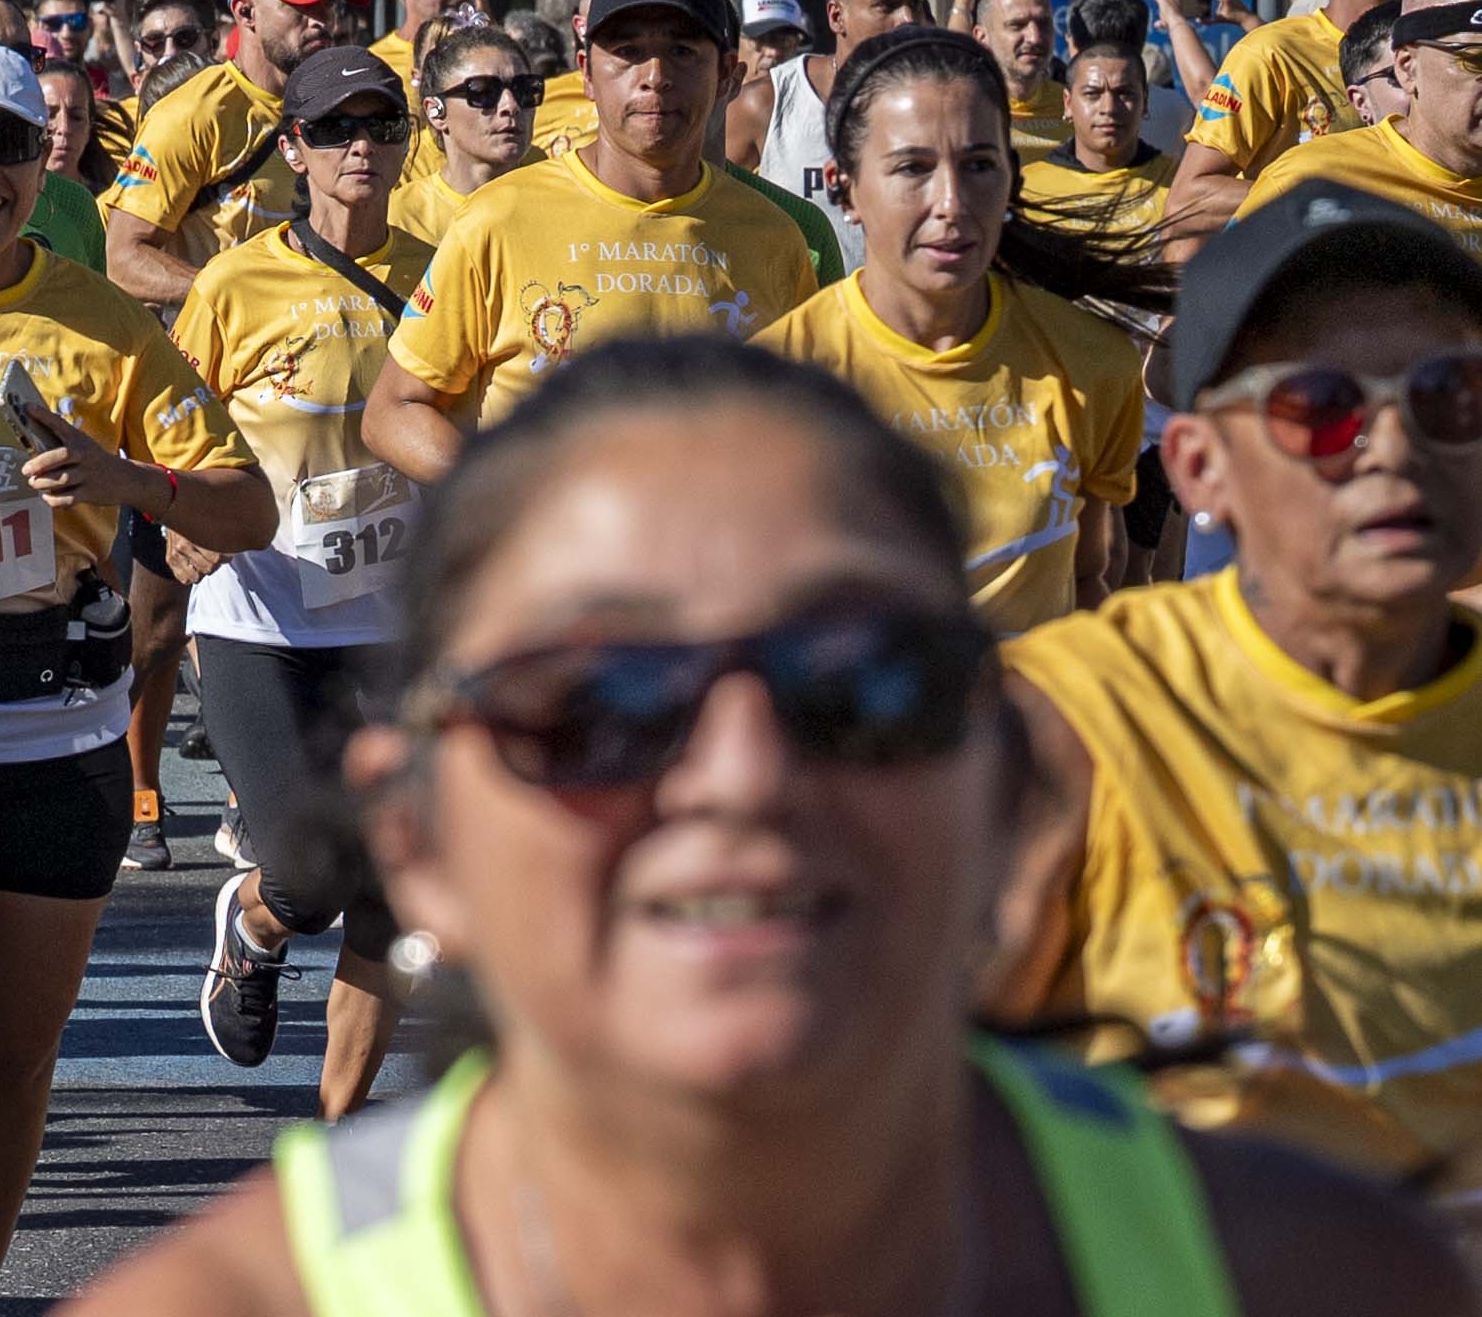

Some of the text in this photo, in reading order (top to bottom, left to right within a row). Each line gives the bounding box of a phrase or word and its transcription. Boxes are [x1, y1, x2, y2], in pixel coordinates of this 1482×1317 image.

[1206, 89, 1243, 114] LADINI
[567, 239, 730, 271] 1° MARATÓN
[595, 273, 710, 299] DORADA
[321, 516, 405, 575] 312
